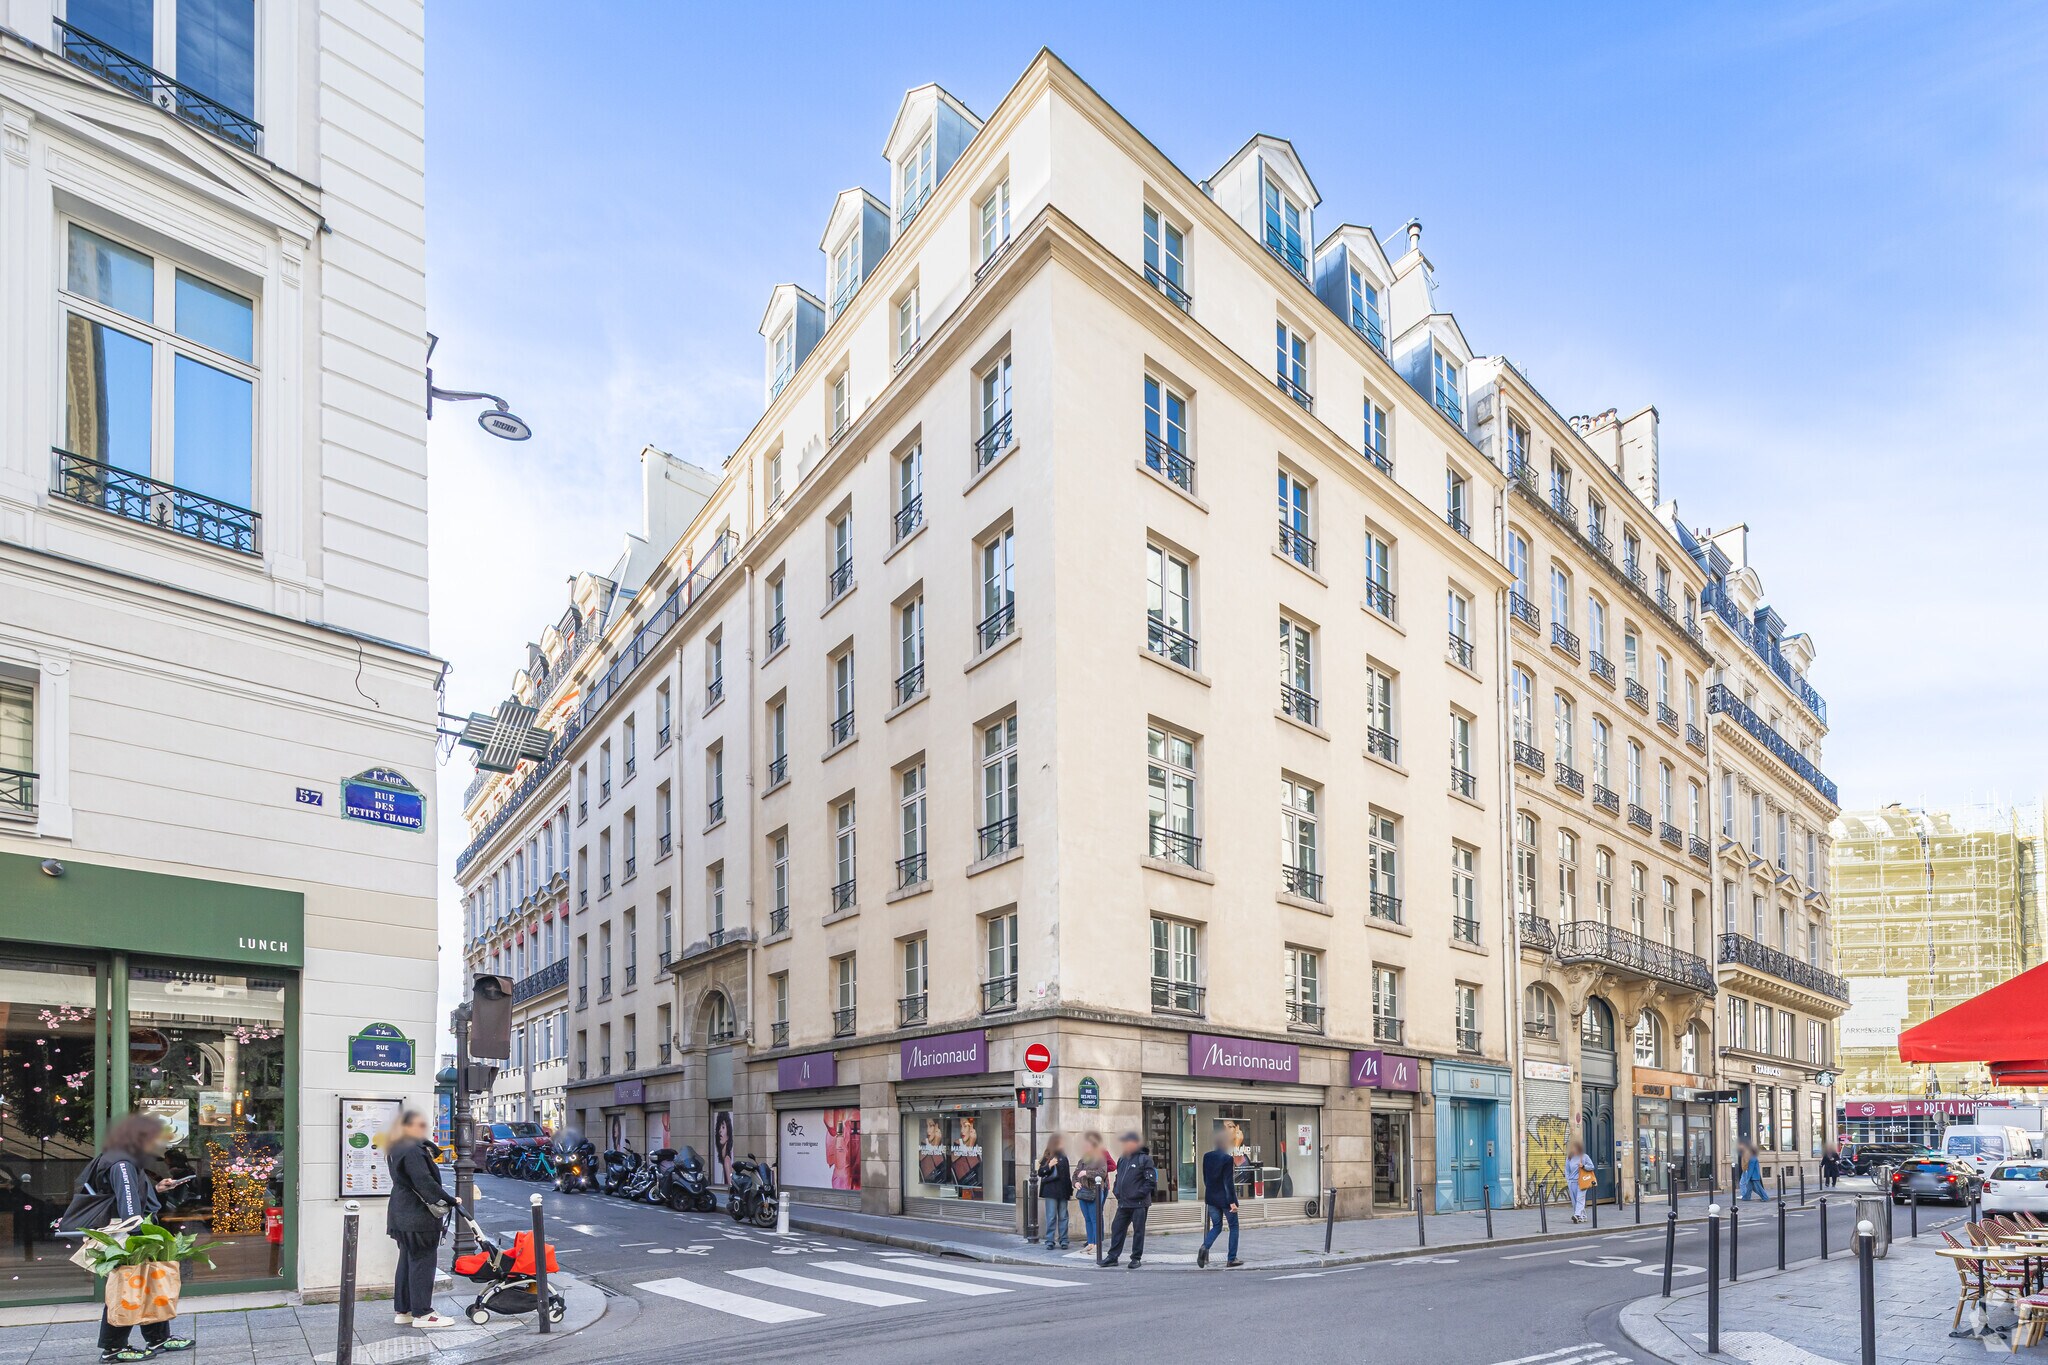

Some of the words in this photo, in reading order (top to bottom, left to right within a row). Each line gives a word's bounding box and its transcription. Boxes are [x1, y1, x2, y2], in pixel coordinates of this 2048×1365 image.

[298, 789, 322, 805] 57
[374, 791, 395, 802] RUE
[375, 801, 395, 812] DES
[346, 805, 381, 819] PETITS
[383, 812, 421, 827] CHAMPS
[239, 937, 288, 953] LUNCH
[357, 1060, 407, 1068] PETITS-CHAMPS
[907, 1043, 977, 1073] Marionnaud
[1203, 1042, 1292, 1072] Marionnaud
[1755, 1064, 1782, 1077] STARBUCKS
[1923, 1101, 1946, 1115] PRET
[1948, 1102, 1955, 1115] A
